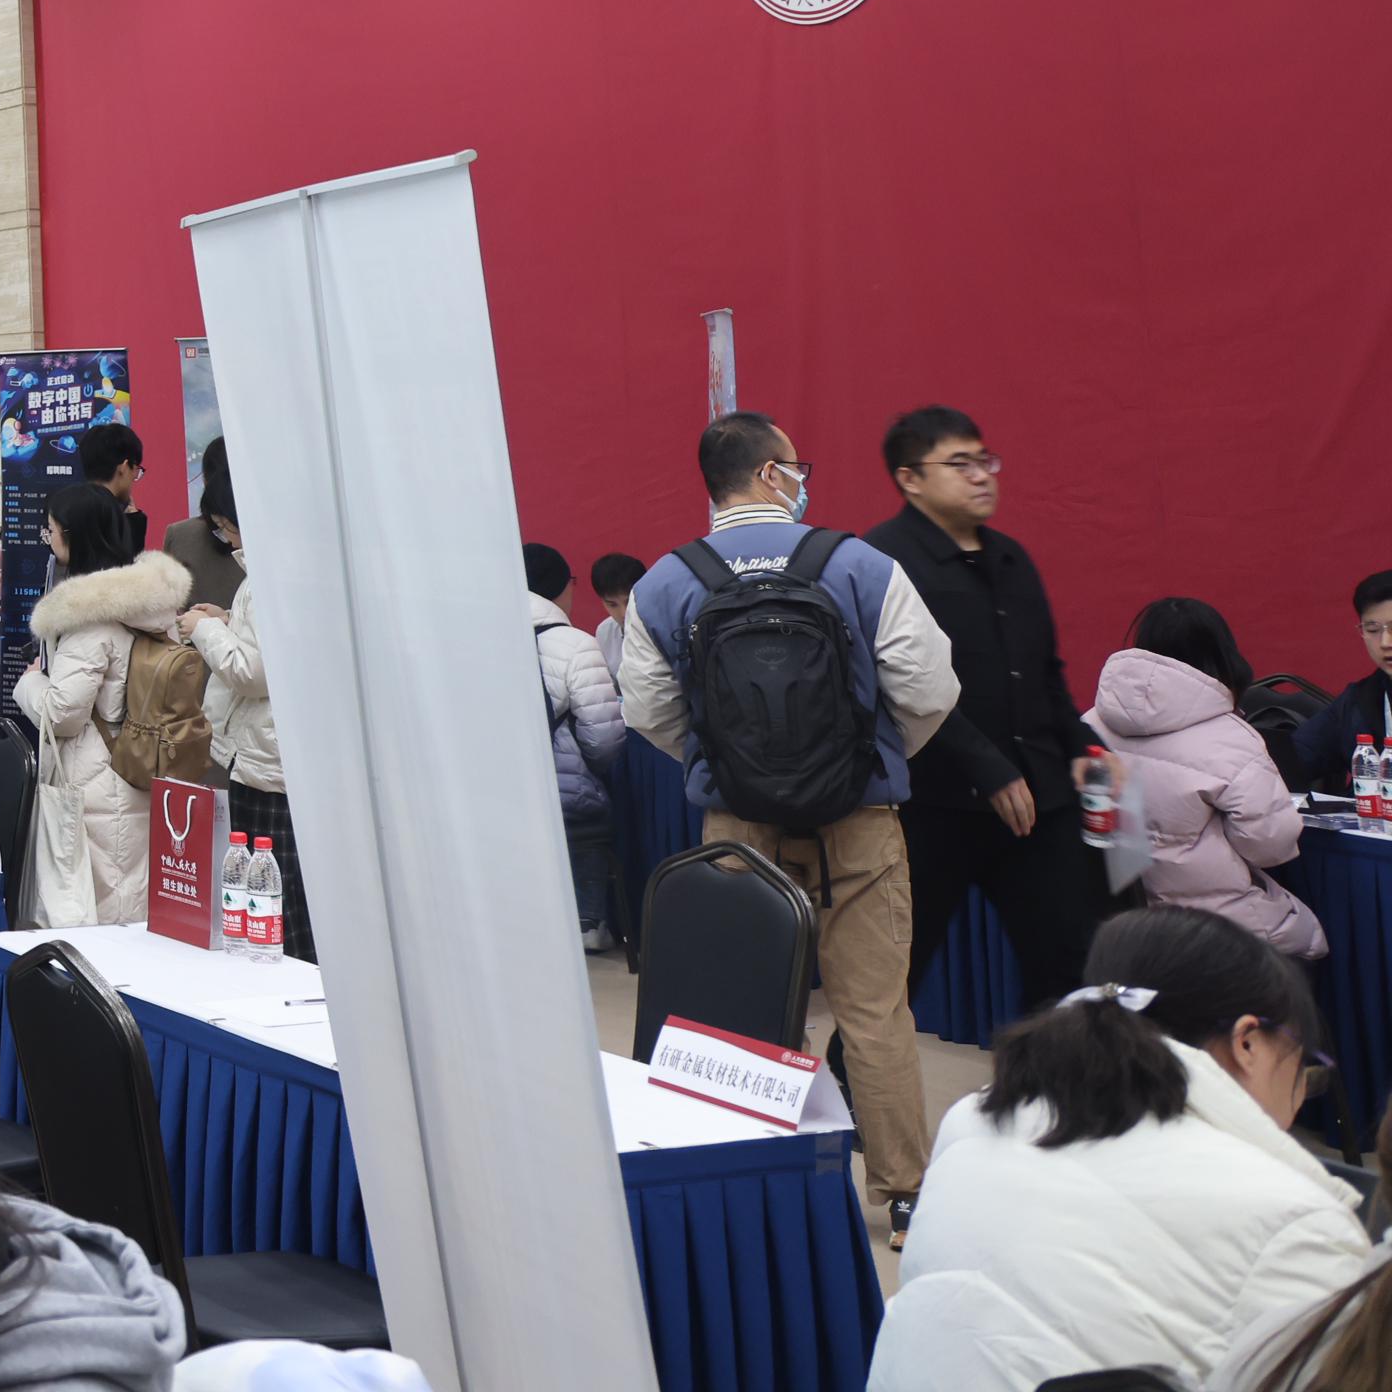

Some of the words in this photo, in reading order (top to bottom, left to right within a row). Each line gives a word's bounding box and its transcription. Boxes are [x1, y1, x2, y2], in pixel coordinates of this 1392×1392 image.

[27, 386, 81, 409] 数字中国
[41, 401, 93, 424] 由你书写
[162, 877, 198, 898] 招生就业处
[657, 1044, 801, 1108] 有研金属复材技术有限公司
